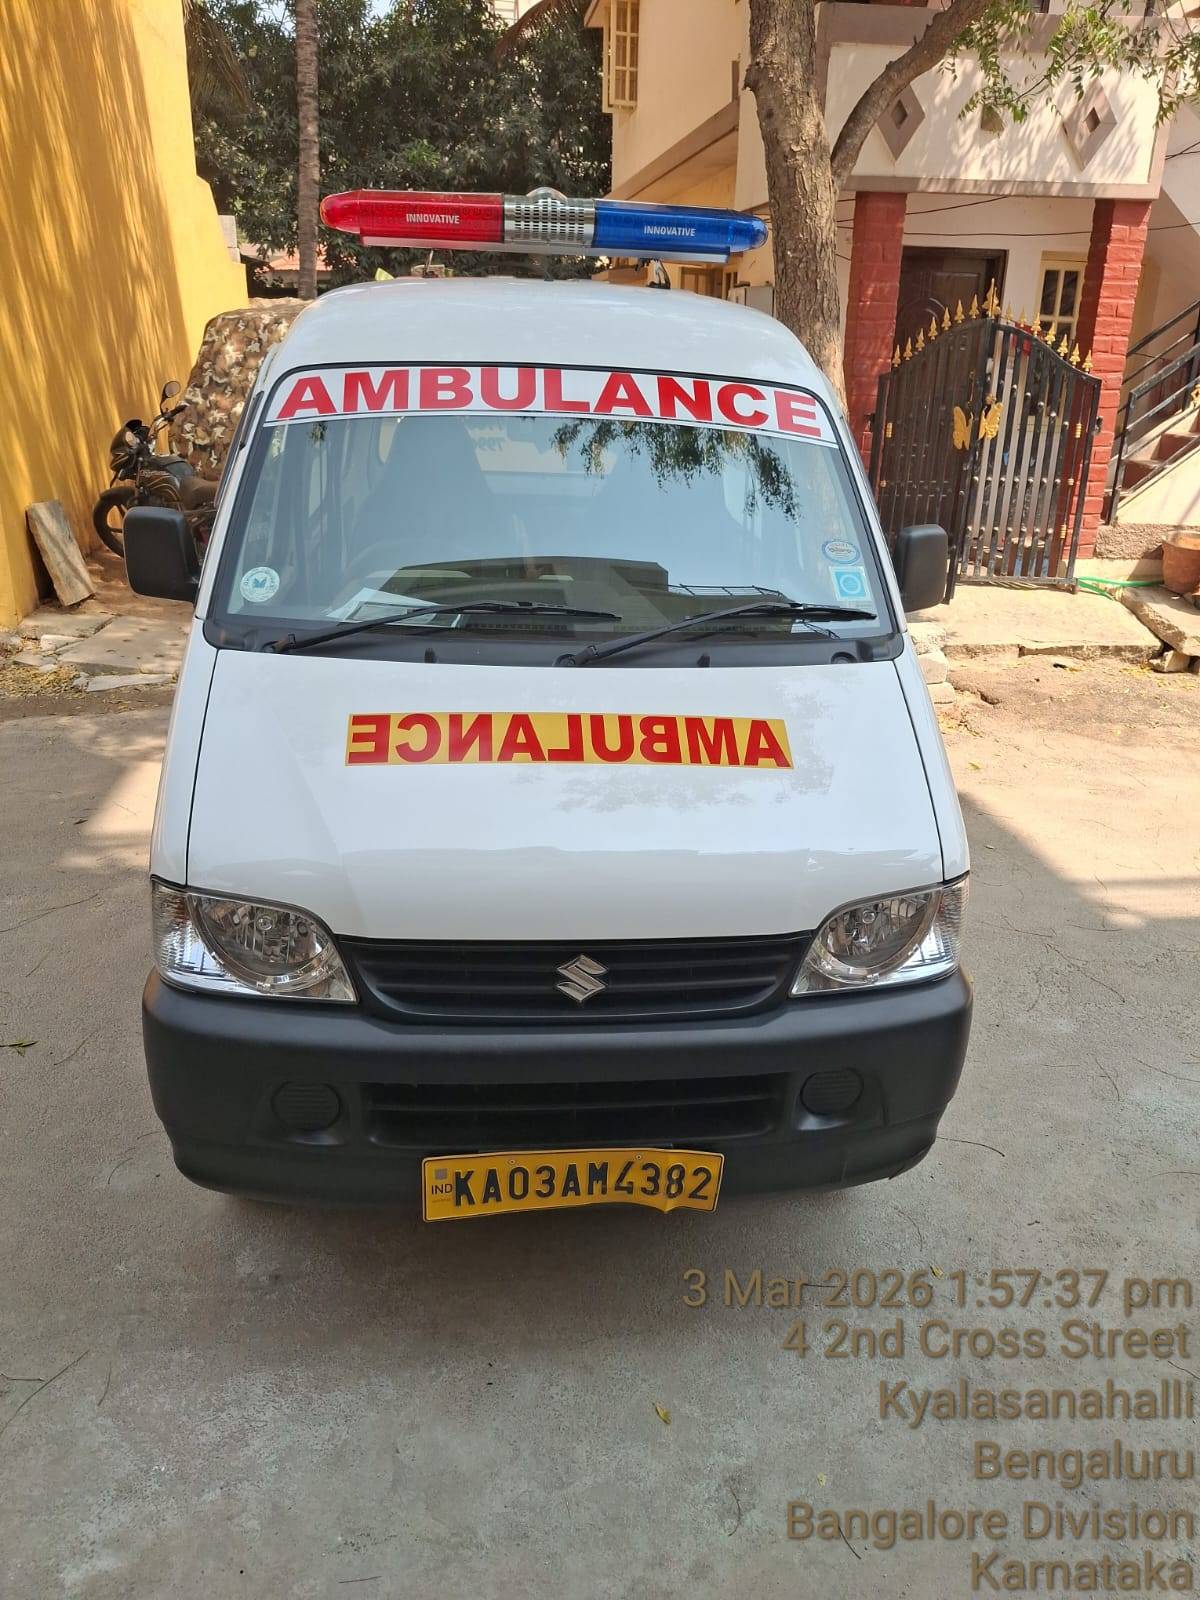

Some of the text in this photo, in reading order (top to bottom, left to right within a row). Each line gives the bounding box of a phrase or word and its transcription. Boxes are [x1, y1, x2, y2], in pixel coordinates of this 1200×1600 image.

[405, 212, 460, 225] INNOVATIVE
[643, 225, 697, 238] INNOVATIVE
[276, 367, 822, 438] AMBULANCE
[431, 1182, 453, 1195] IND
[454, 1161, 712, 1207] KA03AM4382
